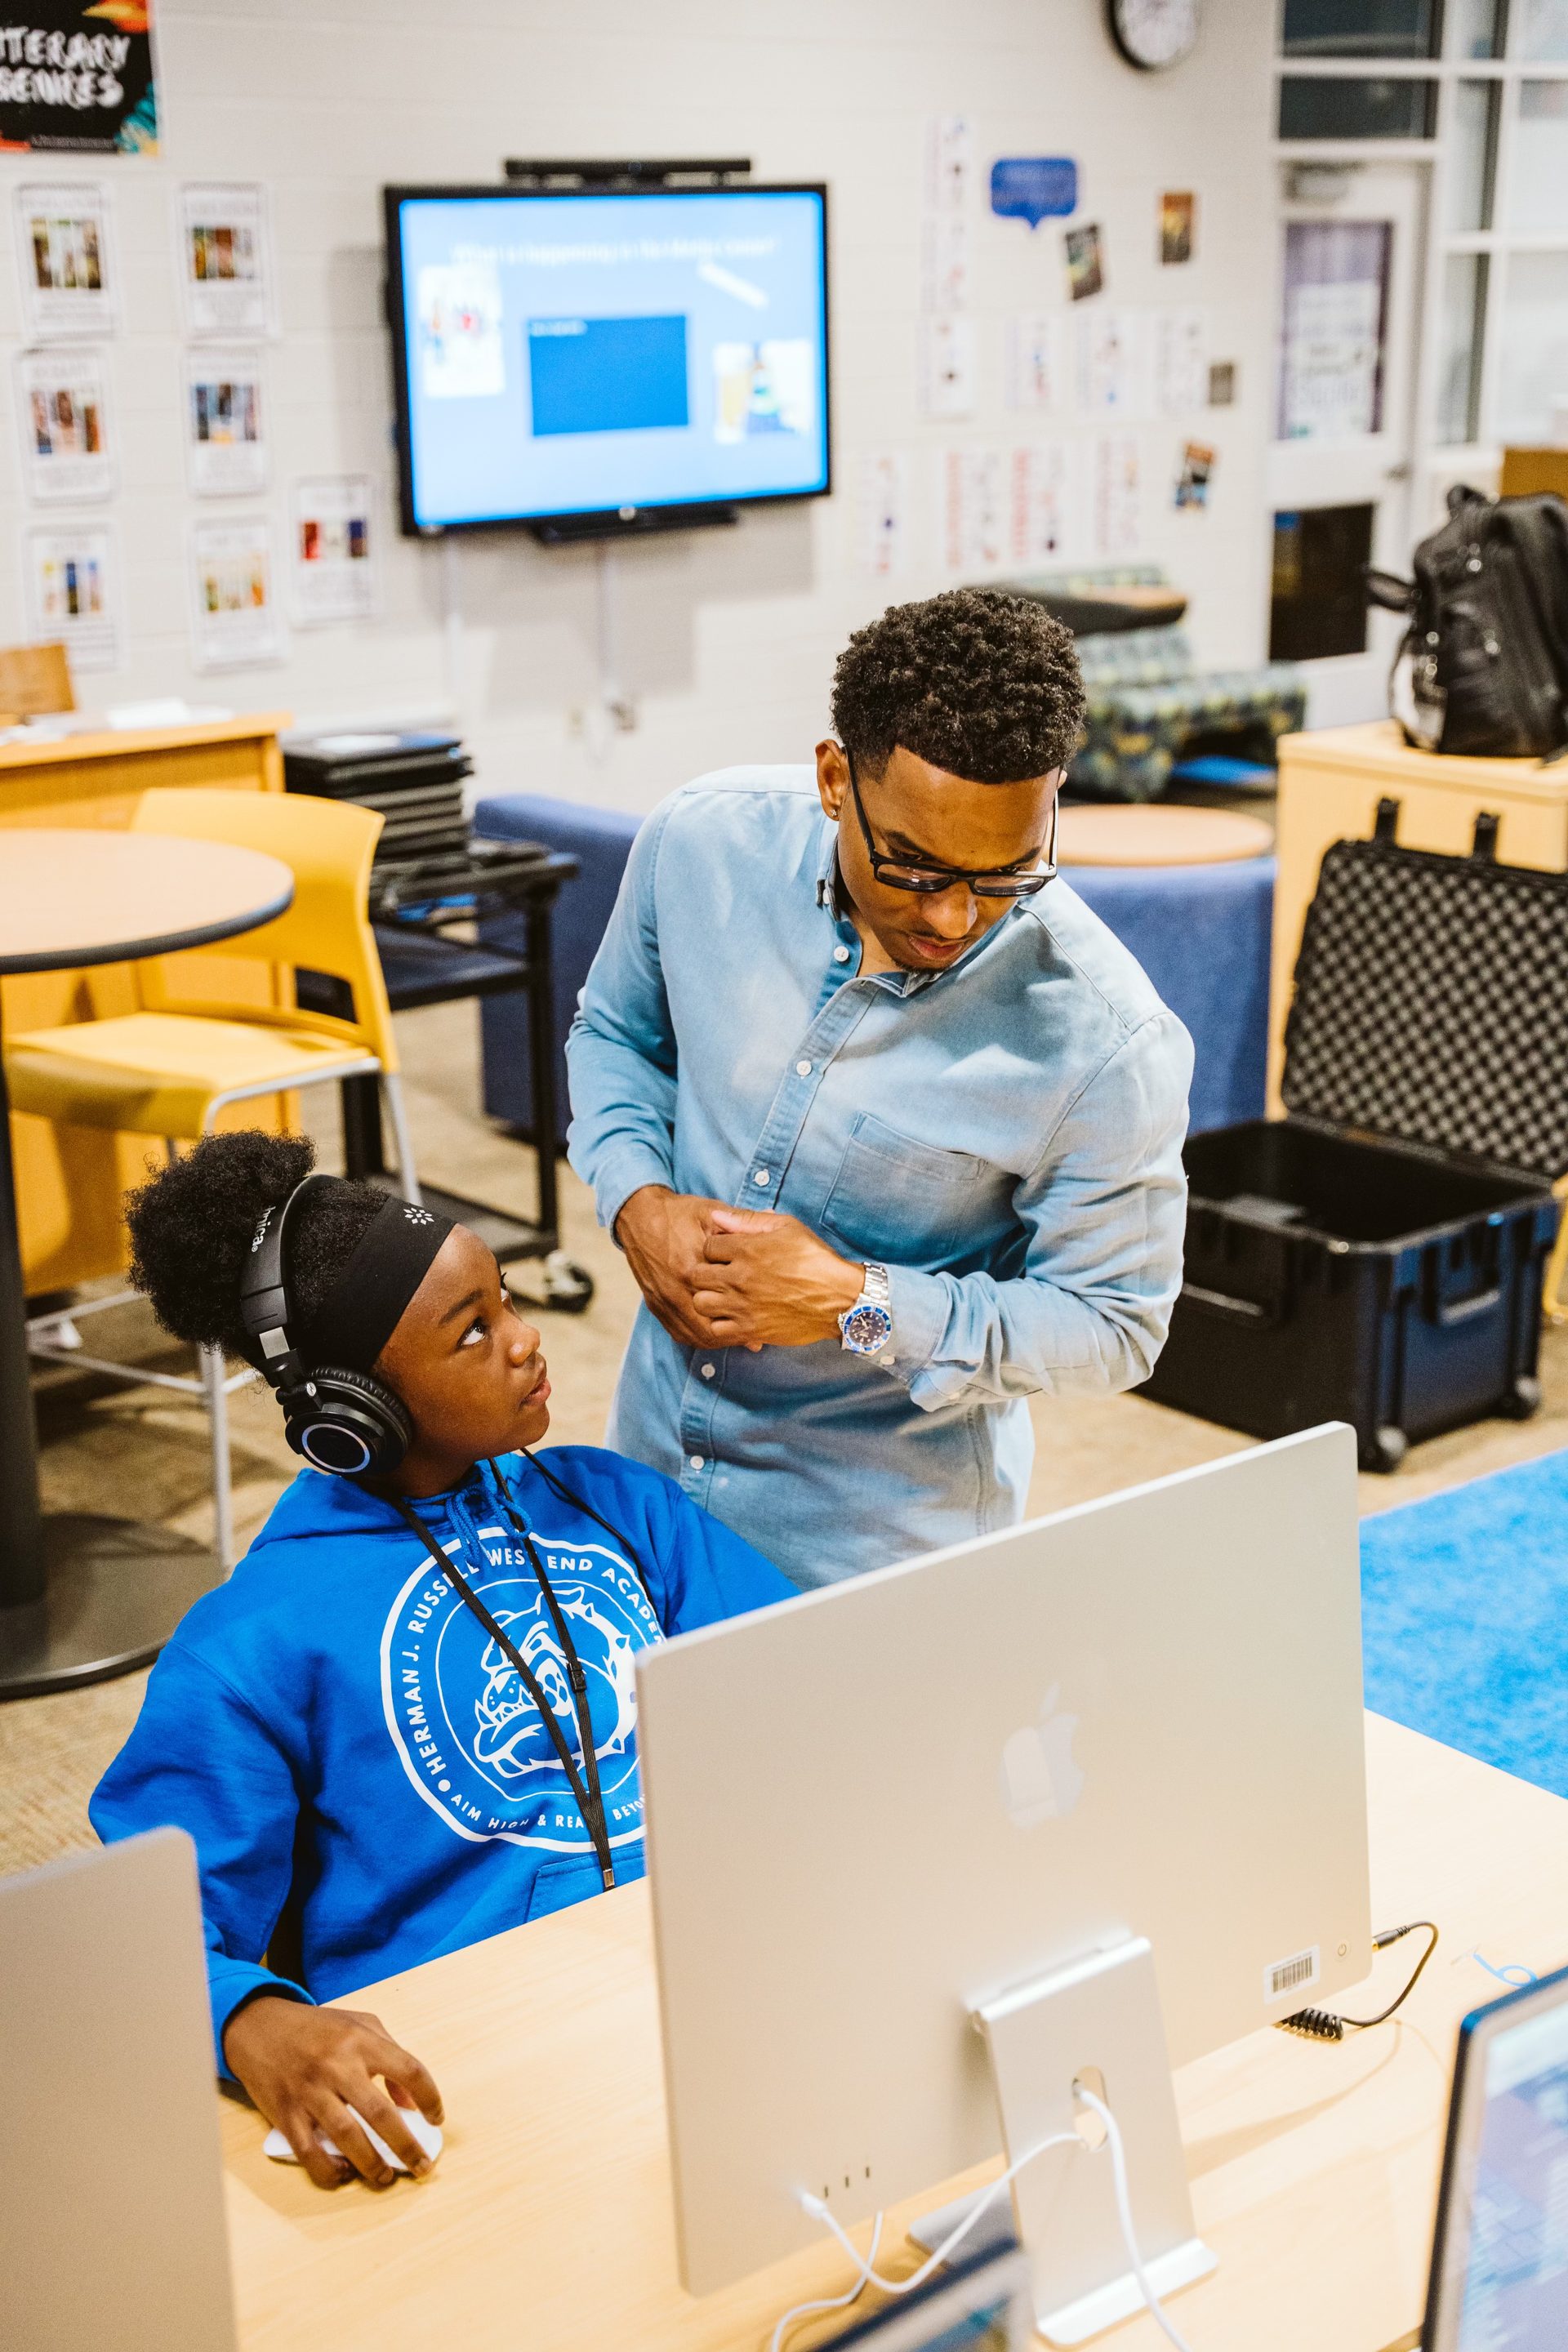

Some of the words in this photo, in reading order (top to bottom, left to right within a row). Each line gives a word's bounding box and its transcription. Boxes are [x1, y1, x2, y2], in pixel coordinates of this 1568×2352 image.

[485, 1548, 537, 1566] WES
[547, 1555, 593, 1571] END
[402, 1645, 420, 1662] J.
[402, 1669, 447, 1775] HERMAN
[451, 1794, 482, 1821] AIM
[488, 1817, 529, 1829] HIGH
[537, 1814, 546, 1827] &
[555, 1815, 585, 1829] REA
